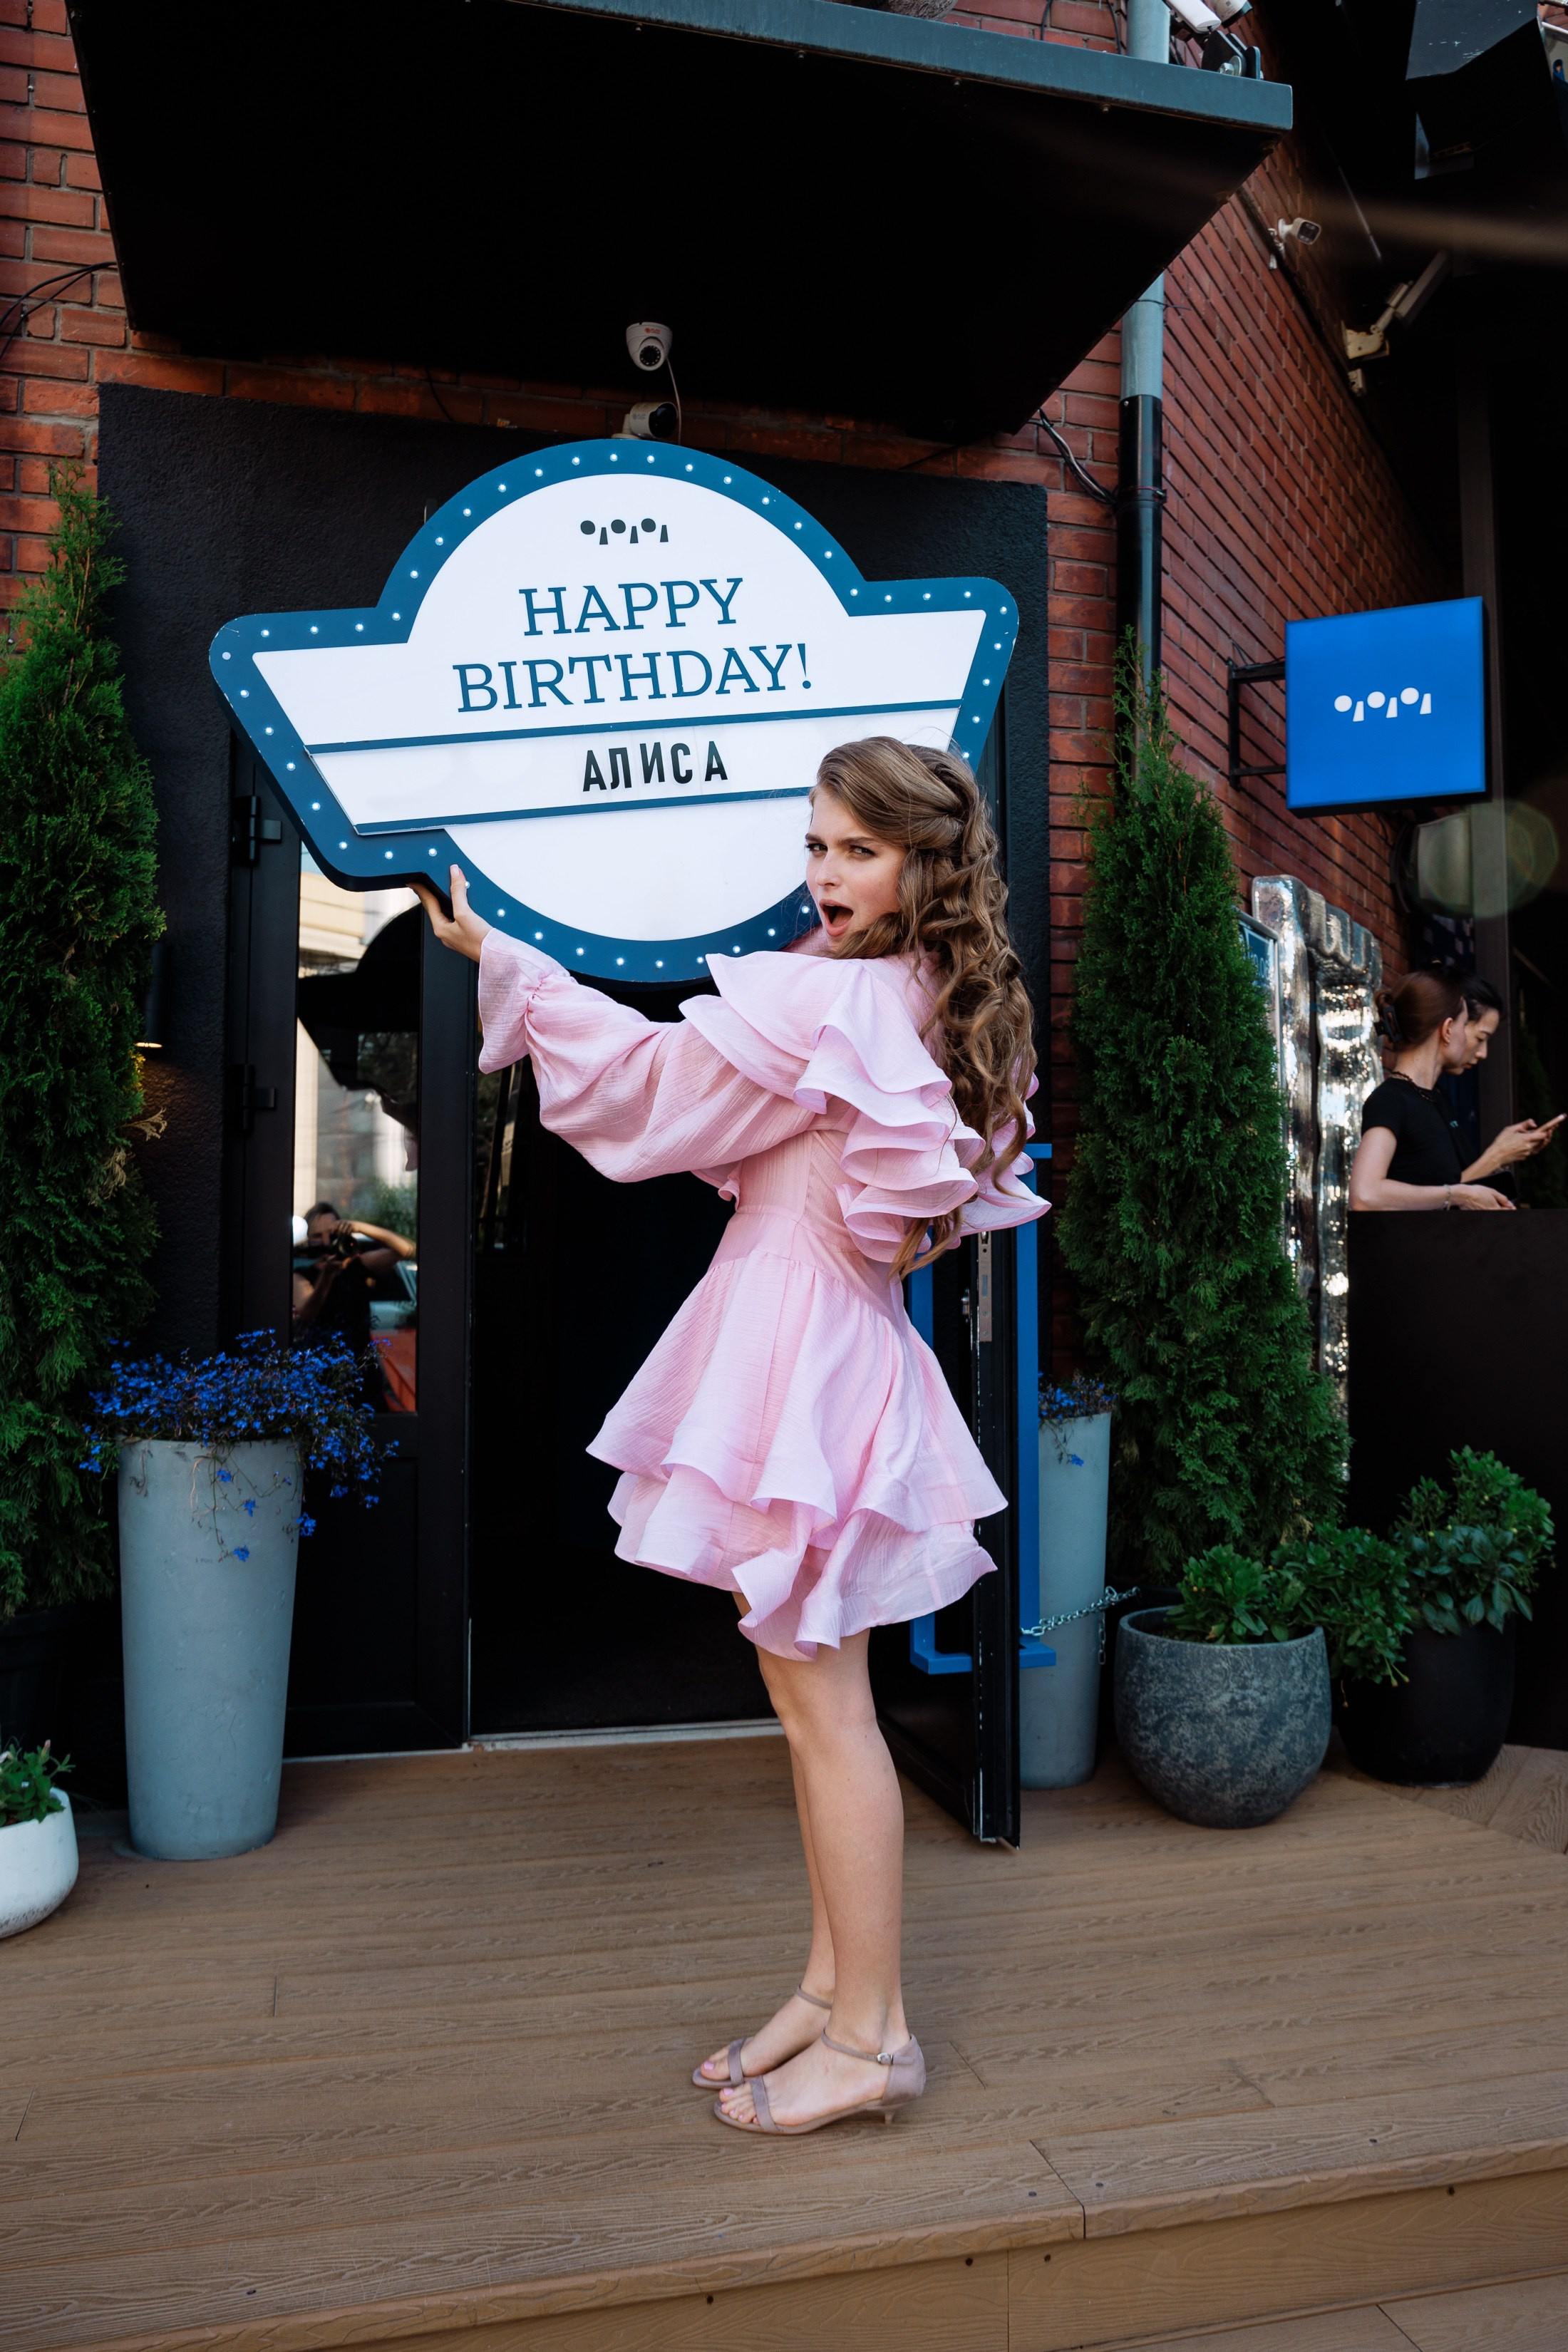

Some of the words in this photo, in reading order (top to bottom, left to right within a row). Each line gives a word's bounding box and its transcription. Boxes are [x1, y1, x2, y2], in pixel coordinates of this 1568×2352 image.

[518, 577, 743, 636] HAPPY
[452, 643, 812, 713] BIRTHDAY!
[582, 741, 728, 792] АЛИСА
